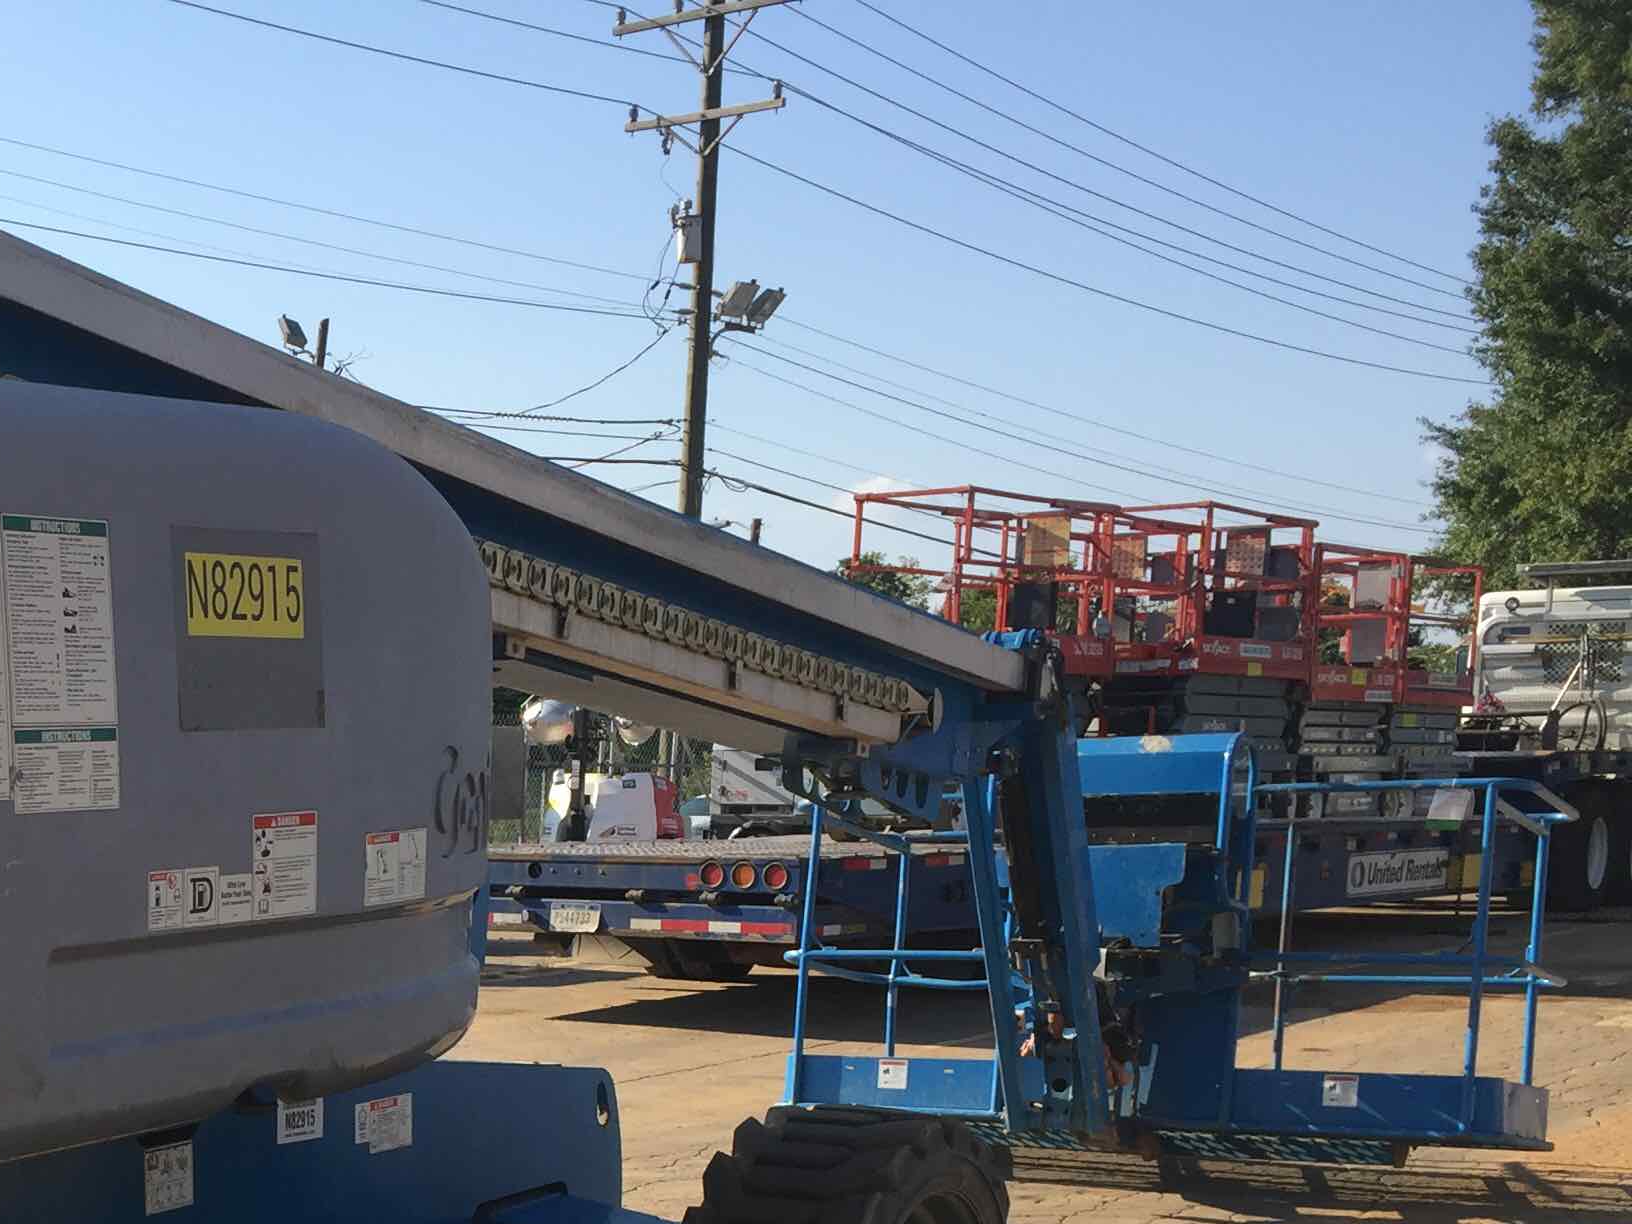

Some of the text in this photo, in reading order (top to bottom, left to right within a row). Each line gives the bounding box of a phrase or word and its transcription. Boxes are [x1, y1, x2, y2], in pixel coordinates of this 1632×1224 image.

[188, 558, 302, 624] N82915
[1368, 859, 1405, 886] United
[285, 1109, 316, 1132] N82915
